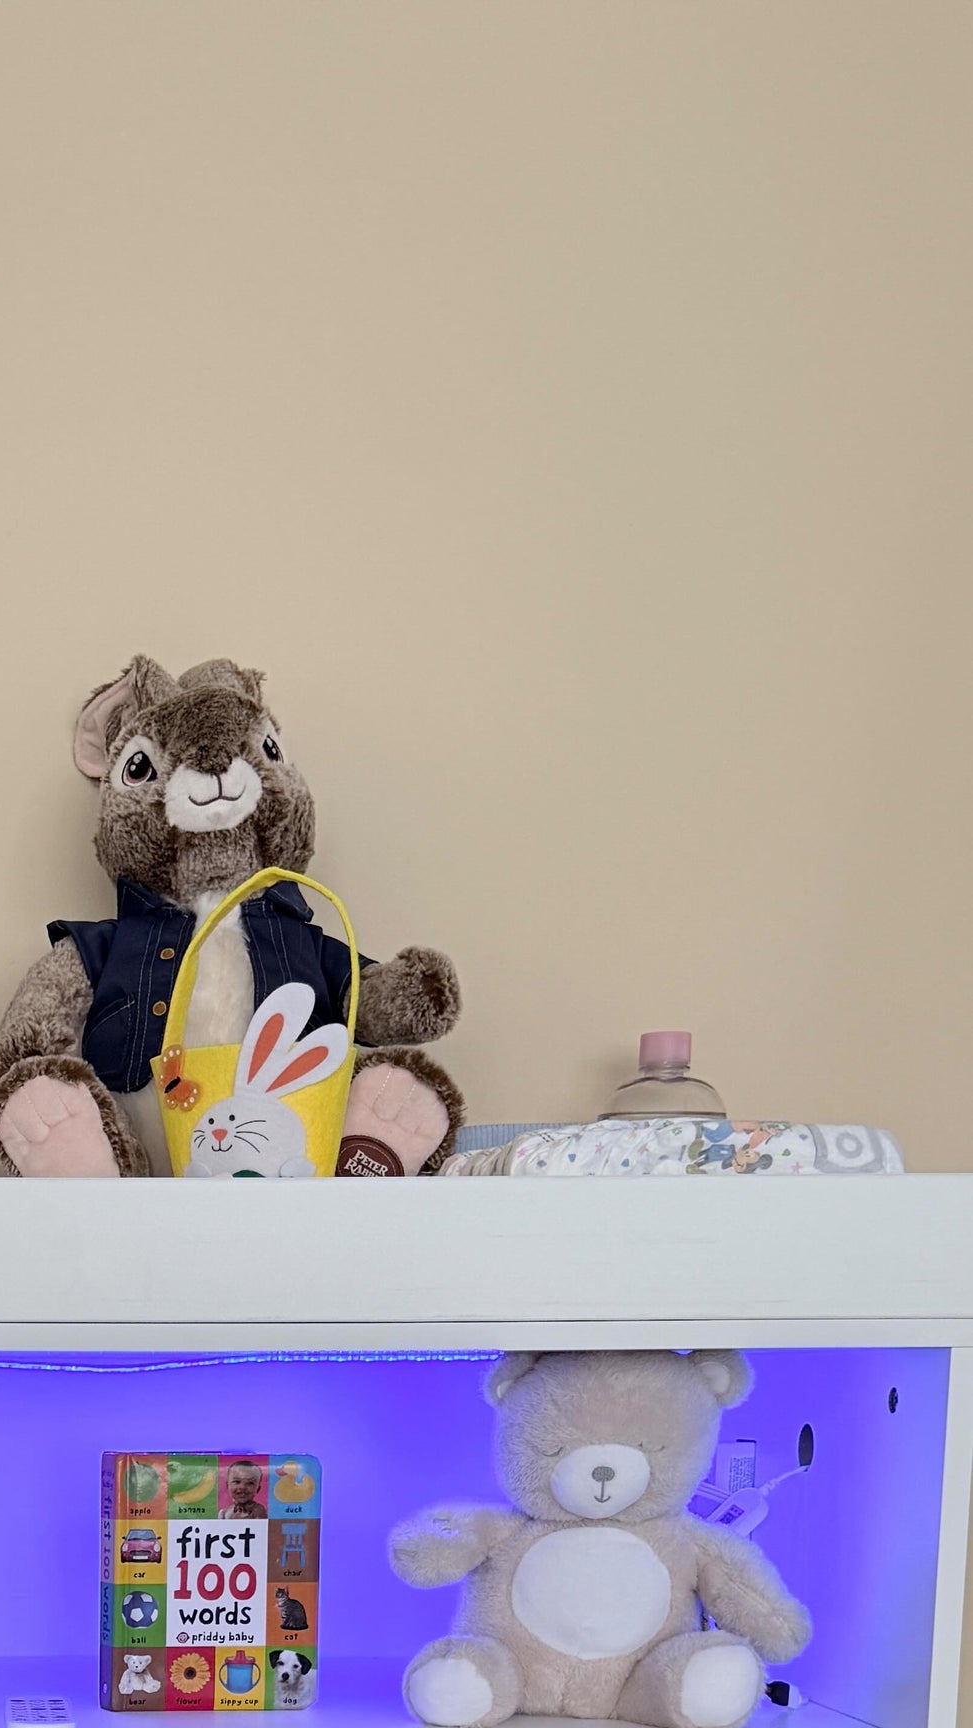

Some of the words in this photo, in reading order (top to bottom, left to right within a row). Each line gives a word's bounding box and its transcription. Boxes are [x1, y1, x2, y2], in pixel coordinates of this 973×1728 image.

[352, 1150, 388, 1177] PETER
[130, 1506, 151, 1516] apple
[178, 1506, 206, 1514] banana
[104, 1496, 113, 1541] first
[176, 1526, 256, 1559] first
[103, 1547, 111, 1579] 100
[133, 1571, 146, 1579] car
[283, 1569, 302, 1577] chair
[174, 1560, 257, 1600] 100
[102, 1586, 110, 1640] words
[179, 1602, 252, 1625] words
[131, 1636, 146, 1644] ball
[191, 1631, 226, 1644] priddy
[228, 1631, 255, 1644] baby
[284, 1633, 298, 1641] cat
[129, 1697, 146, 1705] bear
[176, 1697, 202, 1705] flower
[220, 1697, 242, 1706] sippy
[282, 1697, 298, 1705] dog
